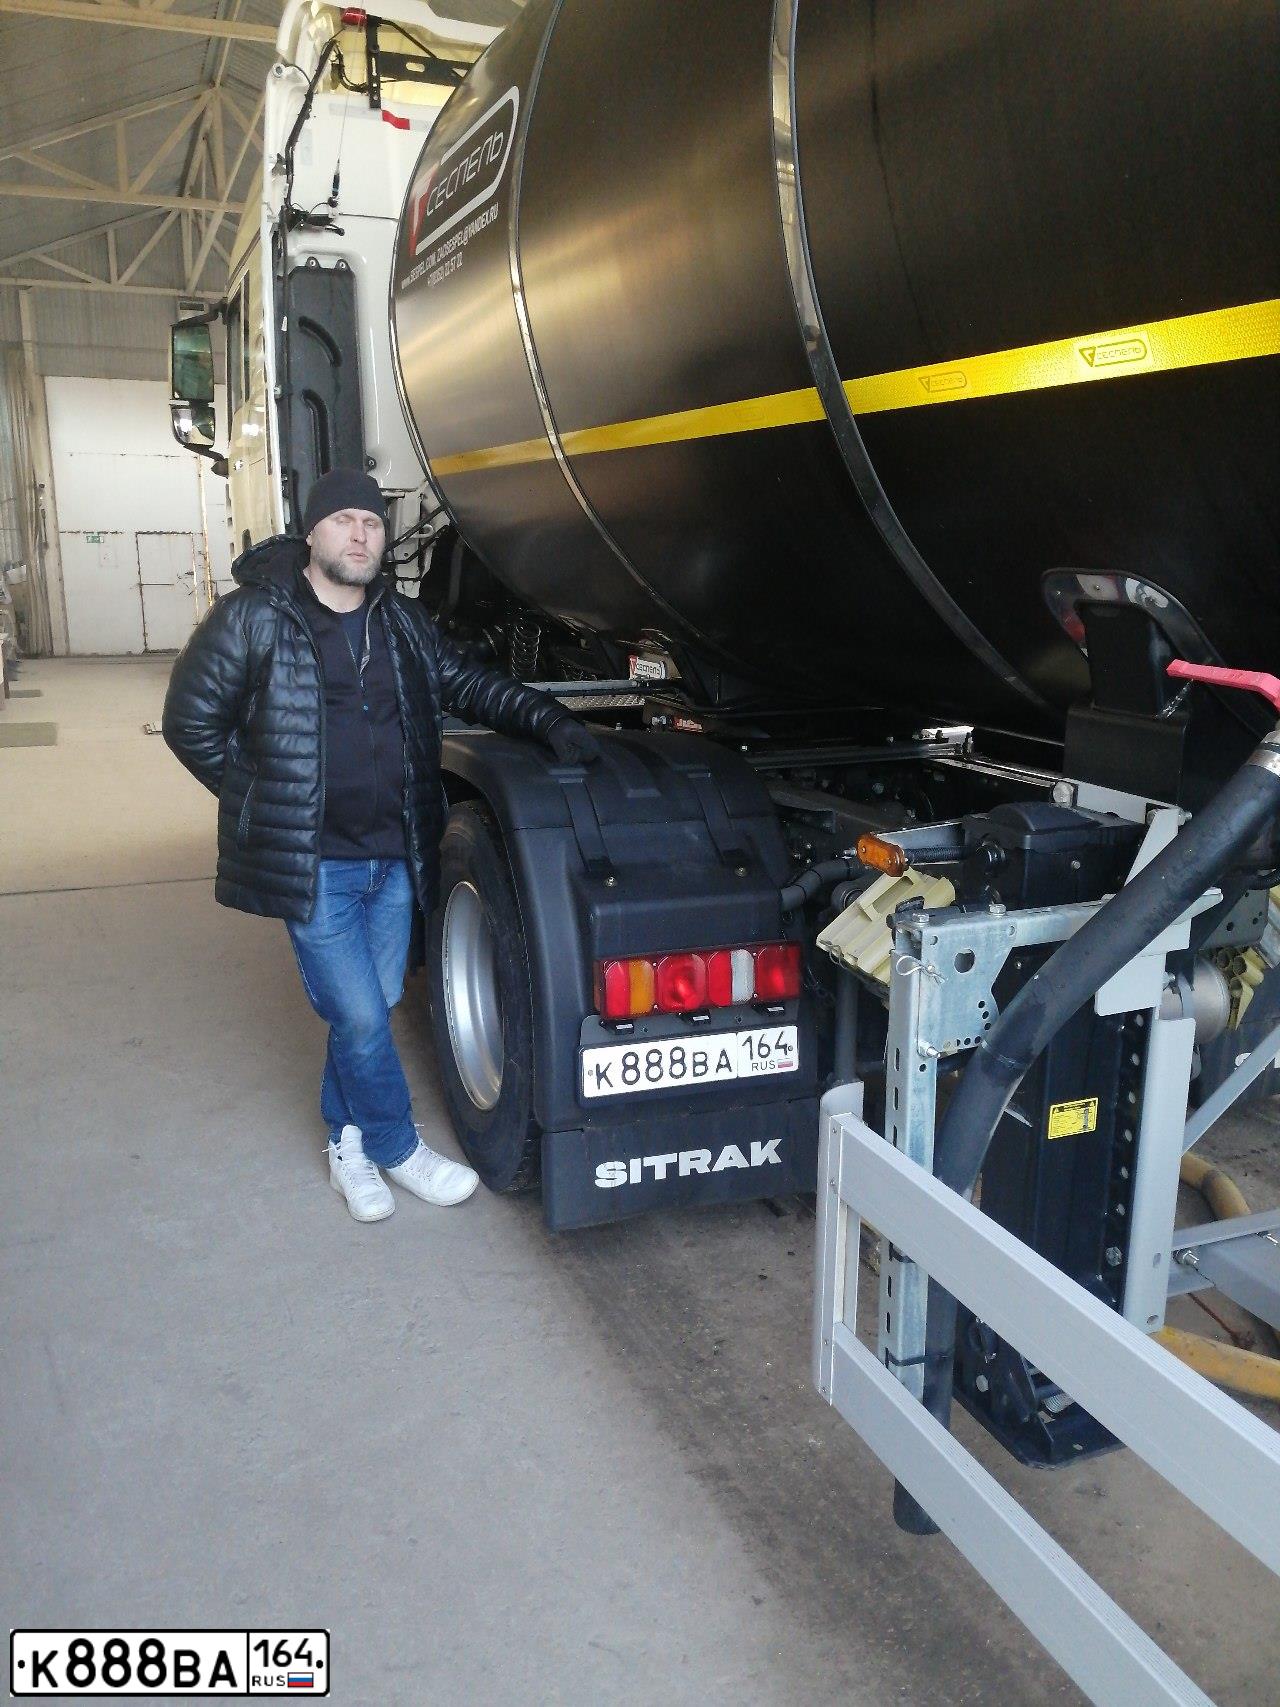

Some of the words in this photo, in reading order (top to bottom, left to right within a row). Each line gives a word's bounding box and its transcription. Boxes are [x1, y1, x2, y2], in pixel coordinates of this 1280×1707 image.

[426, 131, 504, 217] СЕСПЕЛЬ
[595, 1046, 733, 1090] К888ВА
[742, 1030, 788, 1060] 164
[752, 1061, 776, 1072] RUS
[594, 1138, 782, 1189] SITRAK
